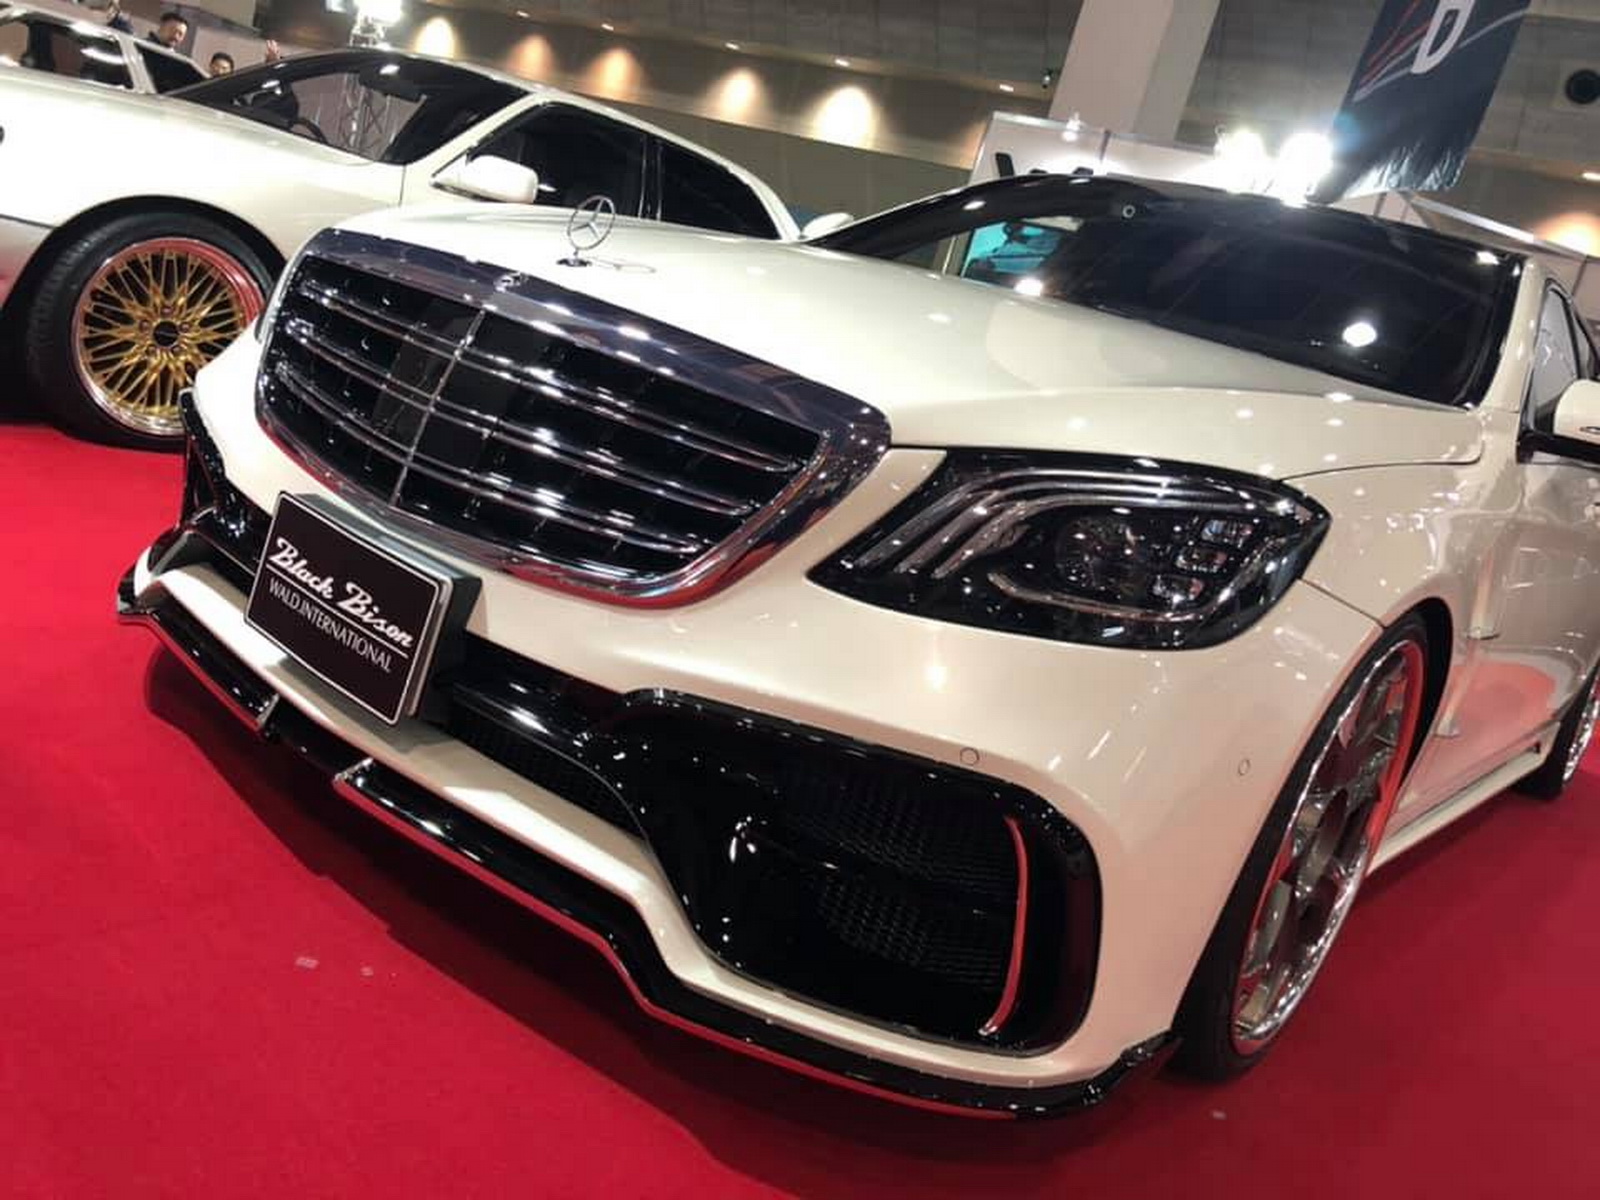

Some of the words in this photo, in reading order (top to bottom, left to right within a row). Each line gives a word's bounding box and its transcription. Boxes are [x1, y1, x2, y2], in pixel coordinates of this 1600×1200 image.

[268, 536, 334, 599] Black
[336, 581, 413, 648] Bison
[299, 599, 392, 673] INTERNATIONAL
